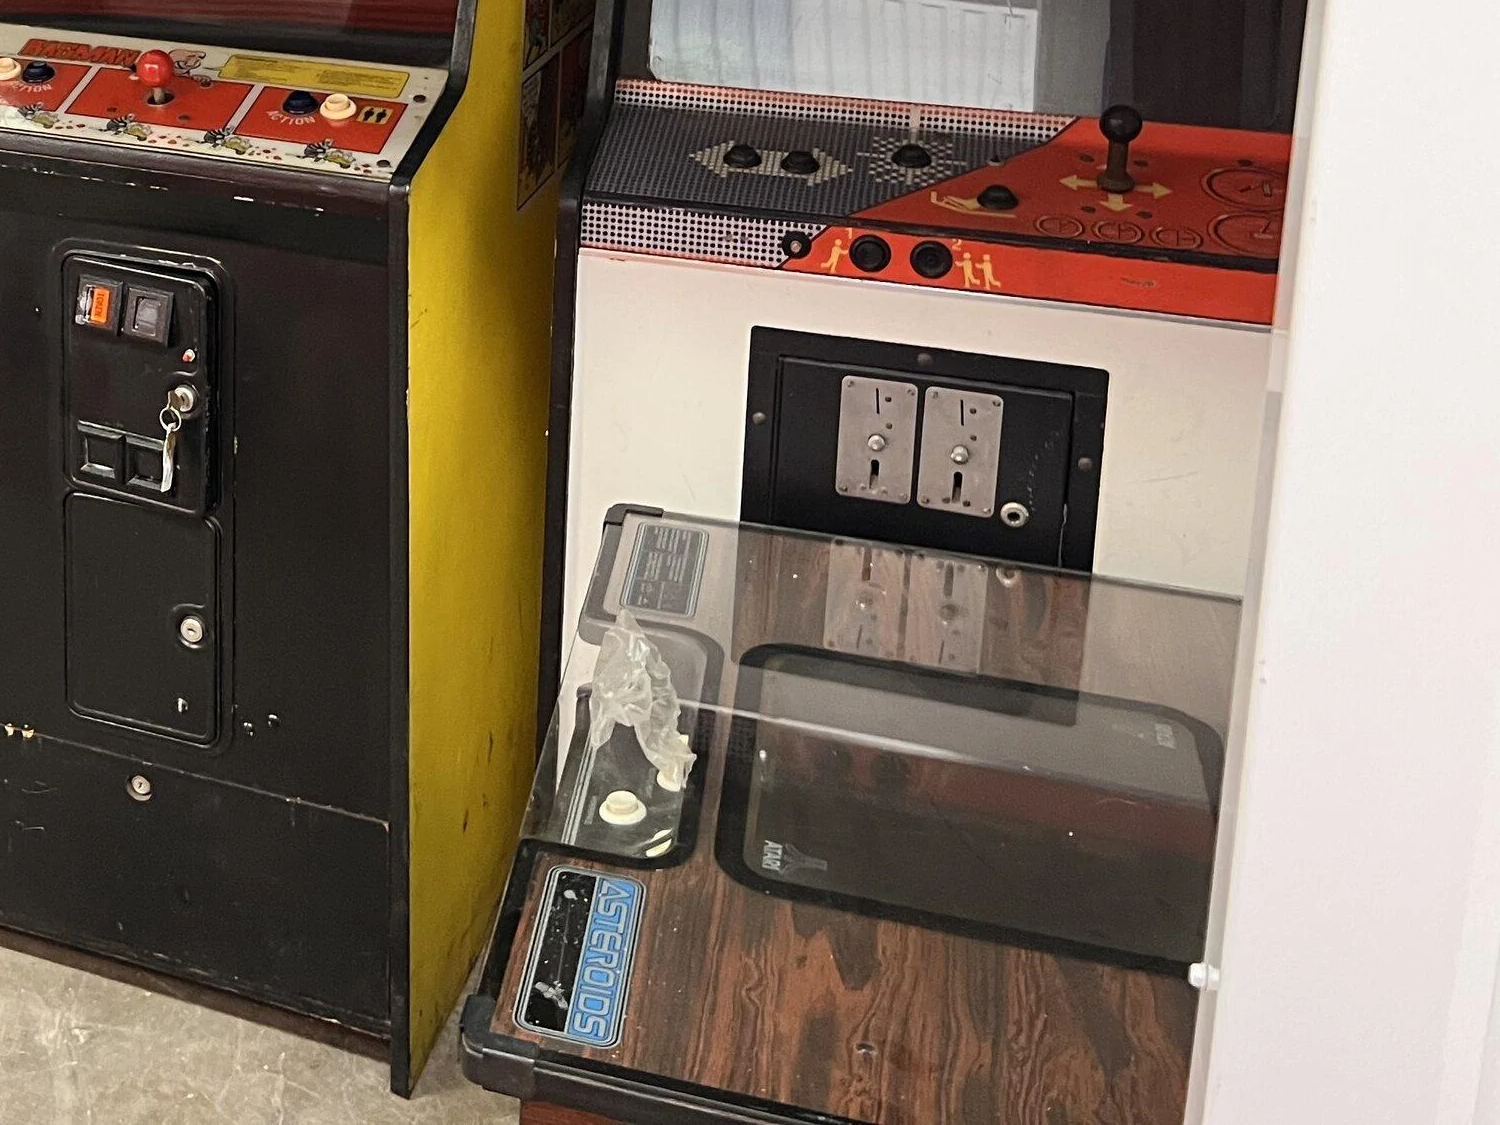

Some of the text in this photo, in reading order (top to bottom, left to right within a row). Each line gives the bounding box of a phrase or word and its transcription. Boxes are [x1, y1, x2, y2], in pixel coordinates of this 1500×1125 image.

[266, 110, 316, 125] ACTION
[762, 840, 783, 870] ATARI
[573, 880, 631, 1038] ASTEROIDS
